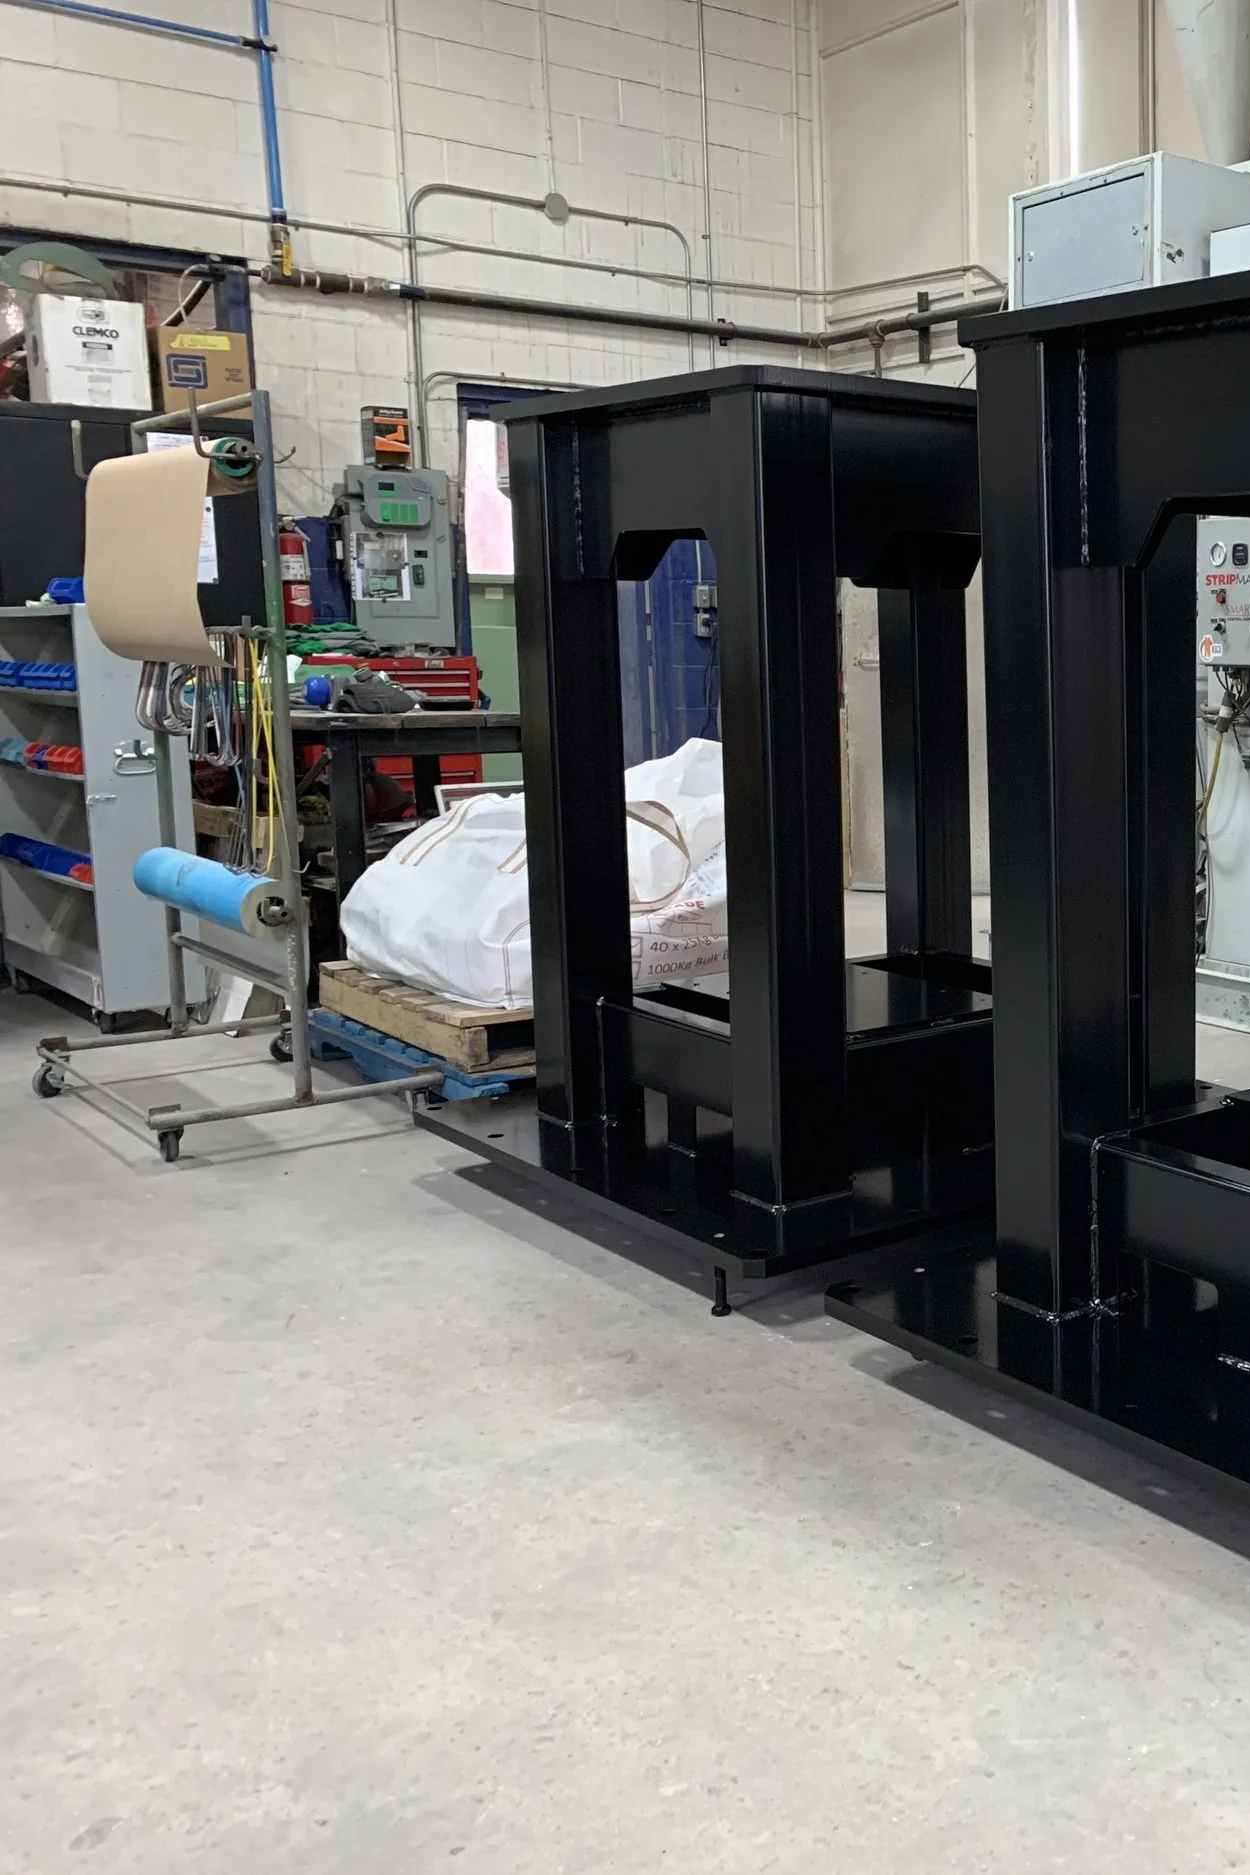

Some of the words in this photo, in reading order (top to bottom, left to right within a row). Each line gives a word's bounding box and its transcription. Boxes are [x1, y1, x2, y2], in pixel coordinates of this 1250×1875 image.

[72, 326, 119, 339] CLEMCO
[650, 942, 669, 952] 40
[648, 961, 692, 975] 1000Kg
[695, 955, 720, 968] Bulk
